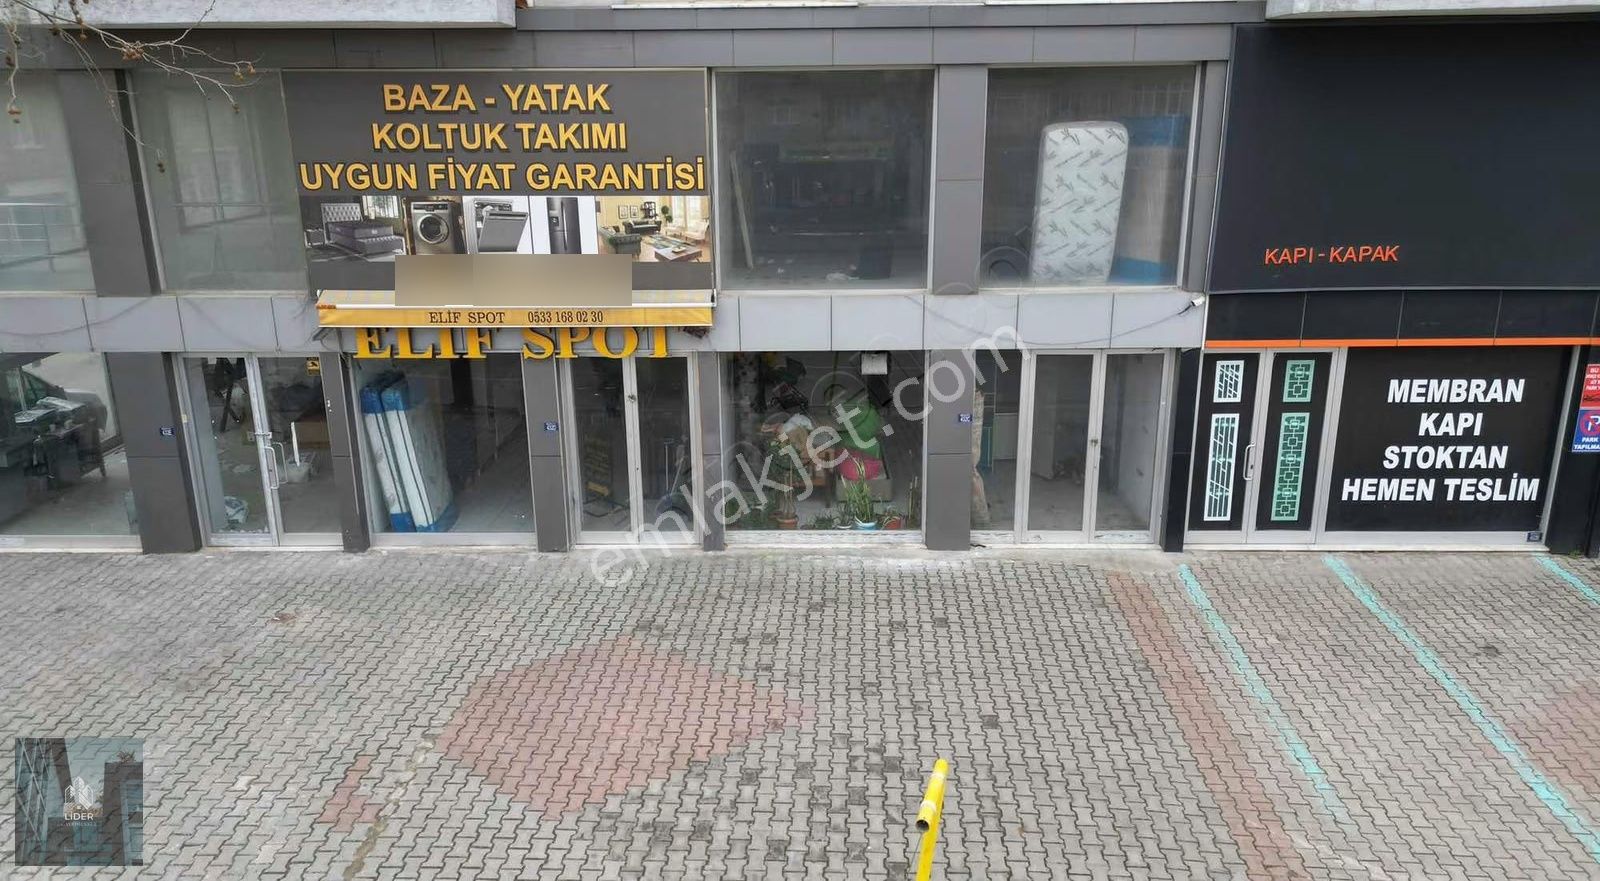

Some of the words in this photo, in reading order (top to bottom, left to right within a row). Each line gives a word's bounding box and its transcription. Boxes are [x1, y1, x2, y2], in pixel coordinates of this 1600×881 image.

[382, 84, 477, 112] BAZA
[503, 83, 611, 112] YATAK
[372, 122, 508, 151] KOLTUK
[516, 122, 628, 151] TAKIMI
[299, 163, 418, 191] UYGUN
[428, 157, 516, 191] FİYAT
[526, 157, 706, 191] GARANTİSİ
[1264, 247, 1314, 265] KAPI
[1329, 245, 1400, 264] KAPAK
[429, 310, 461, 324] ELİF
[468, 311, 506, 324] SPOT
[528, 311, 552, 324] 0533
[555, 311, 573, 324] 168
[576, 310, 589, 324] 02
[591, 310, 604, 324] 30
[521, 328, 668, 359] SPOT
[1387, 378, 1526, 403] MEMBRAN
[1418, 412, 1484, 437] KAPI
[1382, 445, 1509, 470] STOKTAN
[1341, 478, 1436, 502] HEMEN
[1443, 472, 1540, 502] TESLİM
